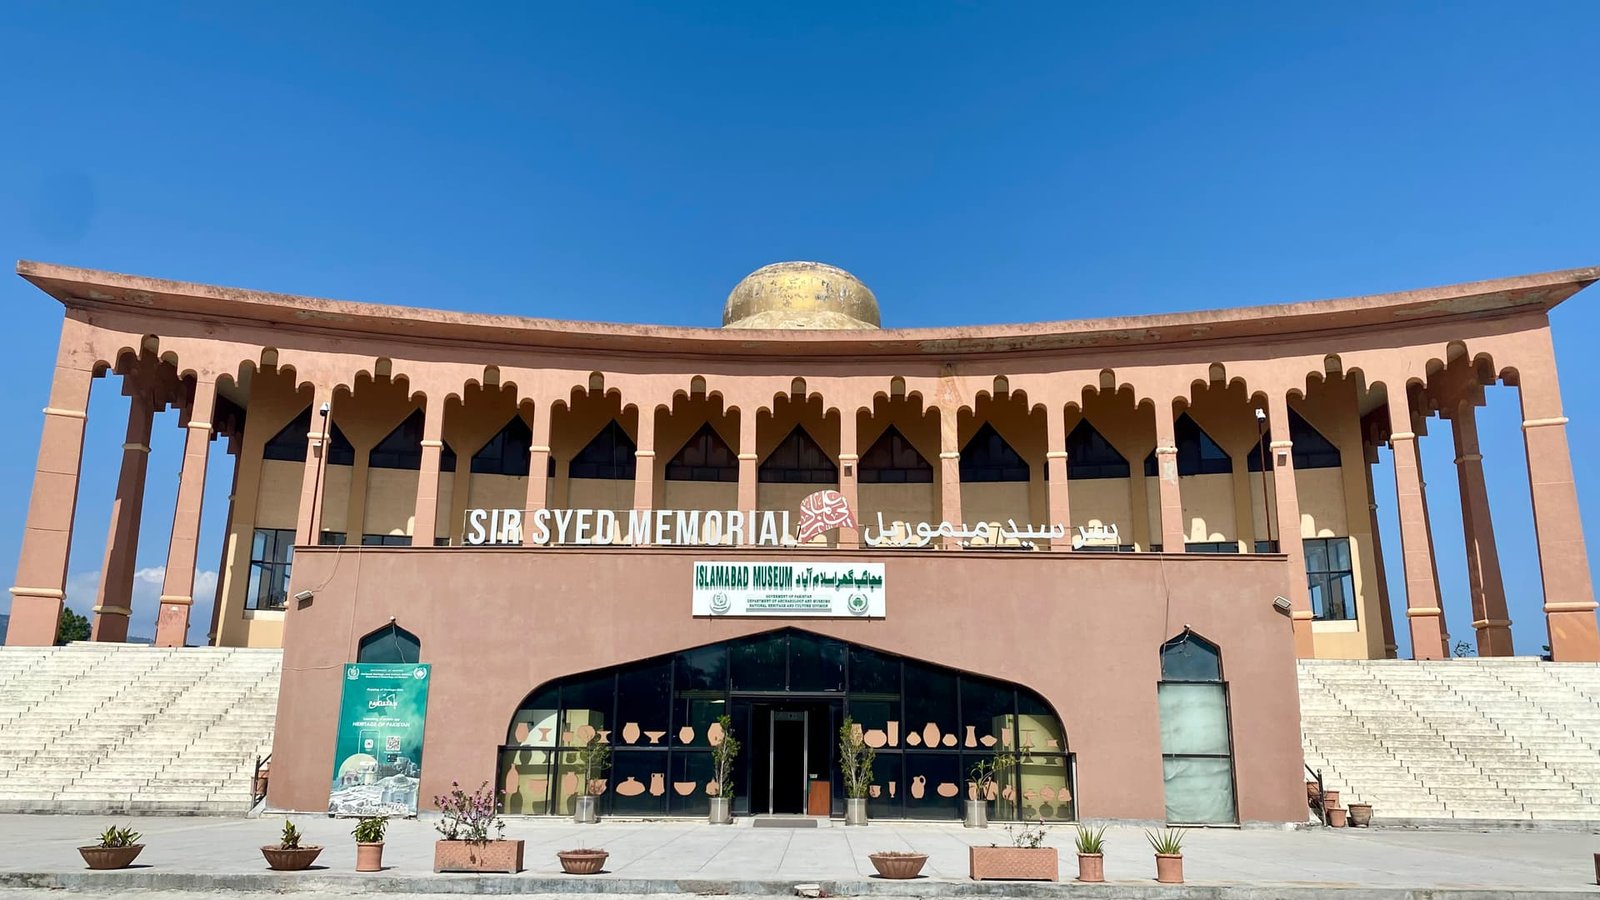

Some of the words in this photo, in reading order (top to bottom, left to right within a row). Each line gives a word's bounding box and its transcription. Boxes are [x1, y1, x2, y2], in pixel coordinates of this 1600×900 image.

[468, 508, 521, 545] SIR
[533, 508, 615, 545] SYED
[628, 509, 795, 546] MEMORIAL
[863, 511, 992, 547] میموریل
[1000, 518, 1065, 548] سید
[1073, 519, 1117, 549] سر
[695, 565, 749, 588] ISLAMABAD
[752, 566, 793, 588] MUSEUM
